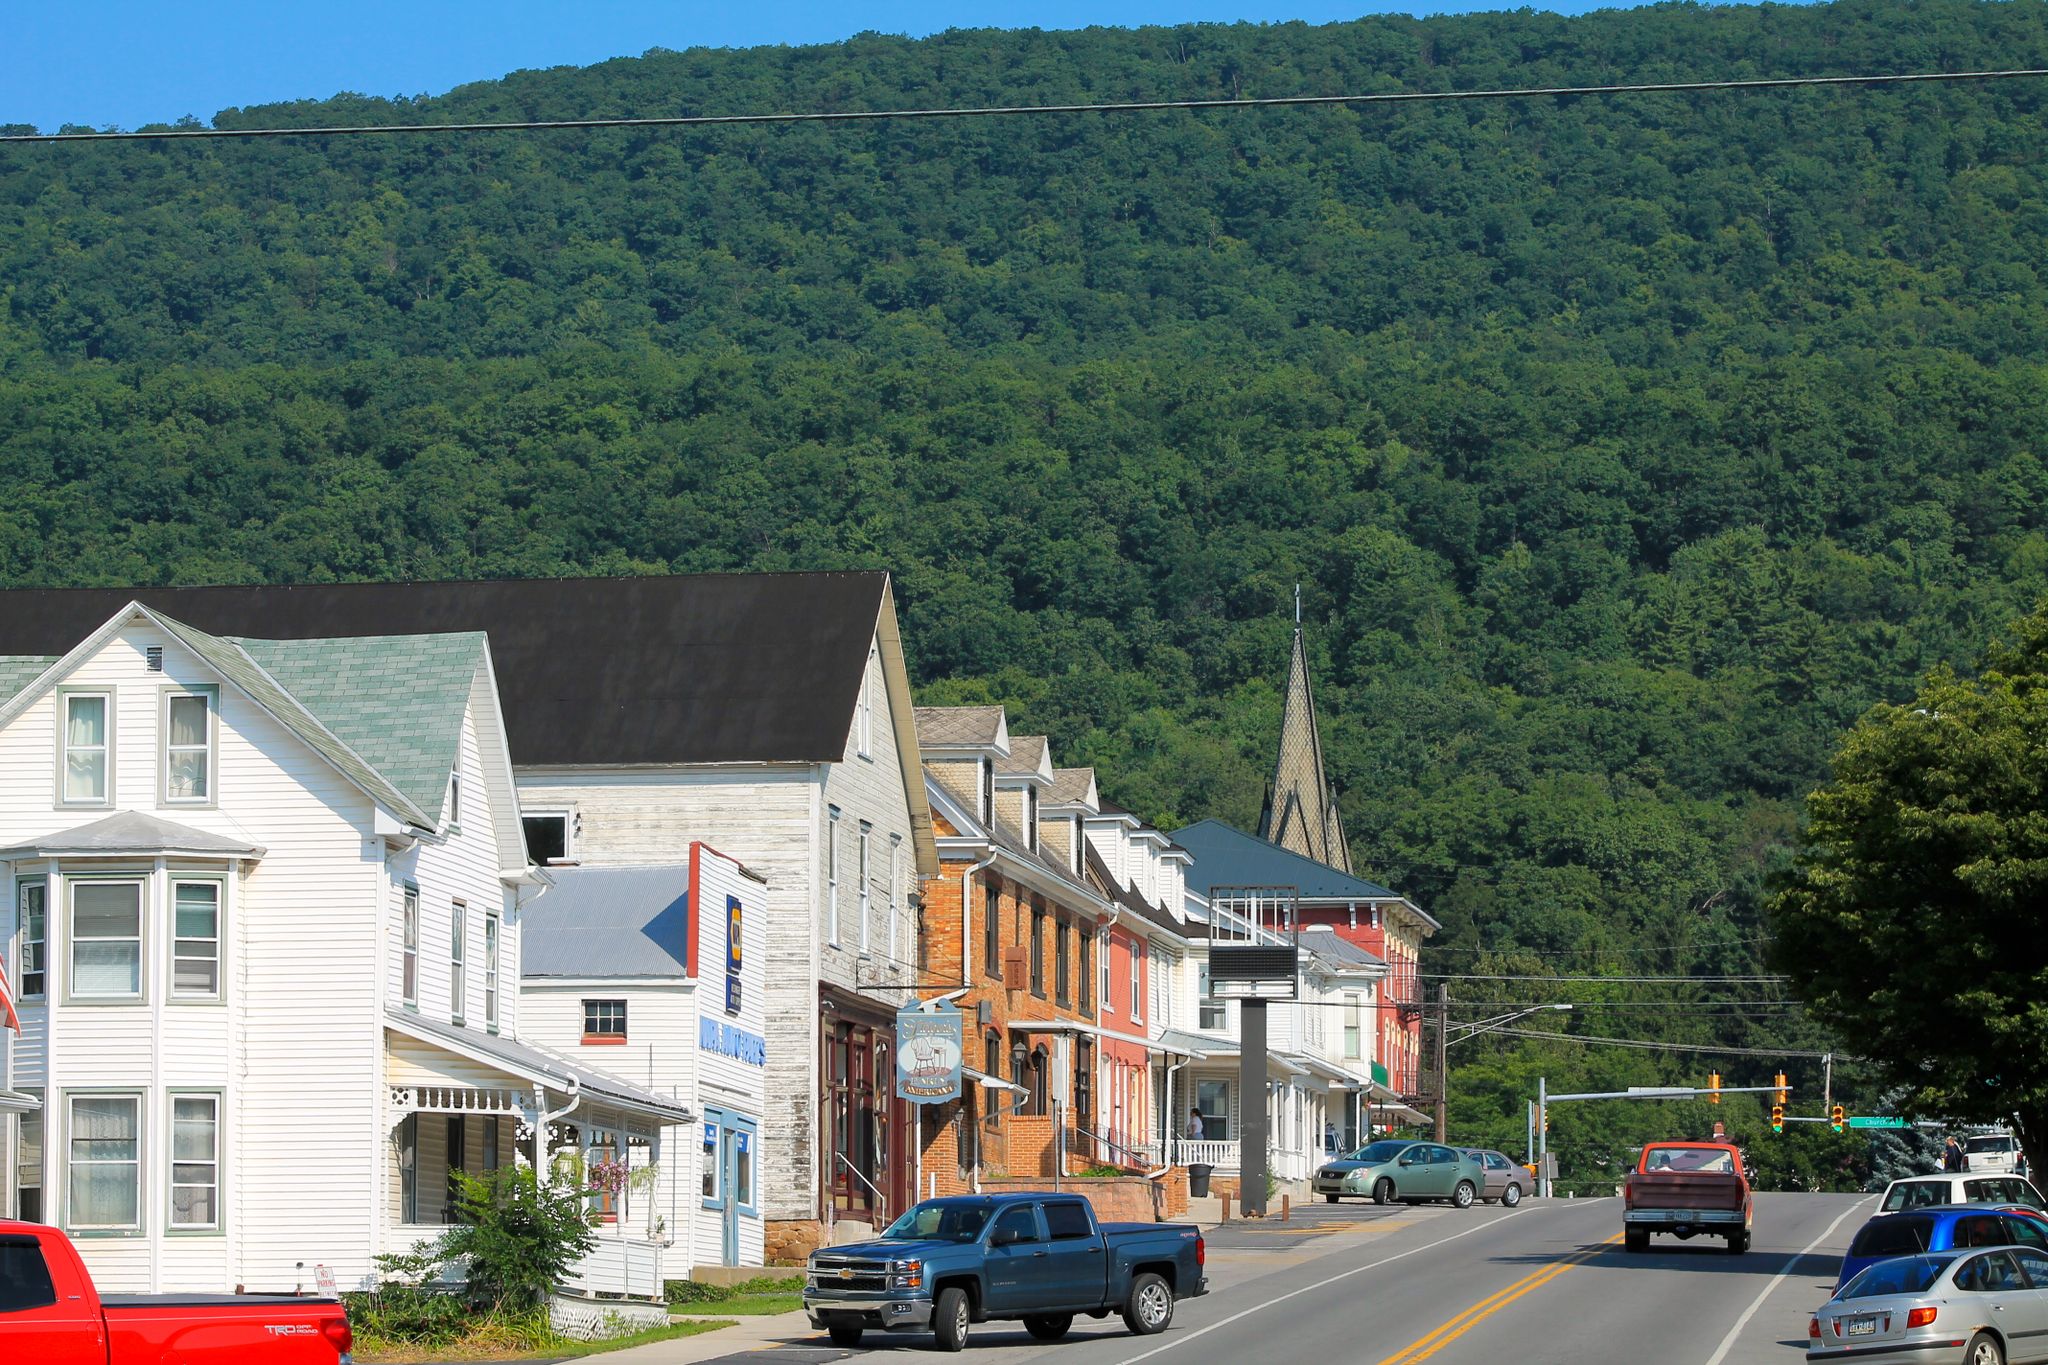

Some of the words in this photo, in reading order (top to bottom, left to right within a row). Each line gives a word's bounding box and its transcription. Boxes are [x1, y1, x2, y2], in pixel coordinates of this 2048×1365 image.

[905, 1085, 953, 1096] AMERICANA
[320, 1270, 329, 1278] NO
[264, 1324, 297, 1336] TRD
